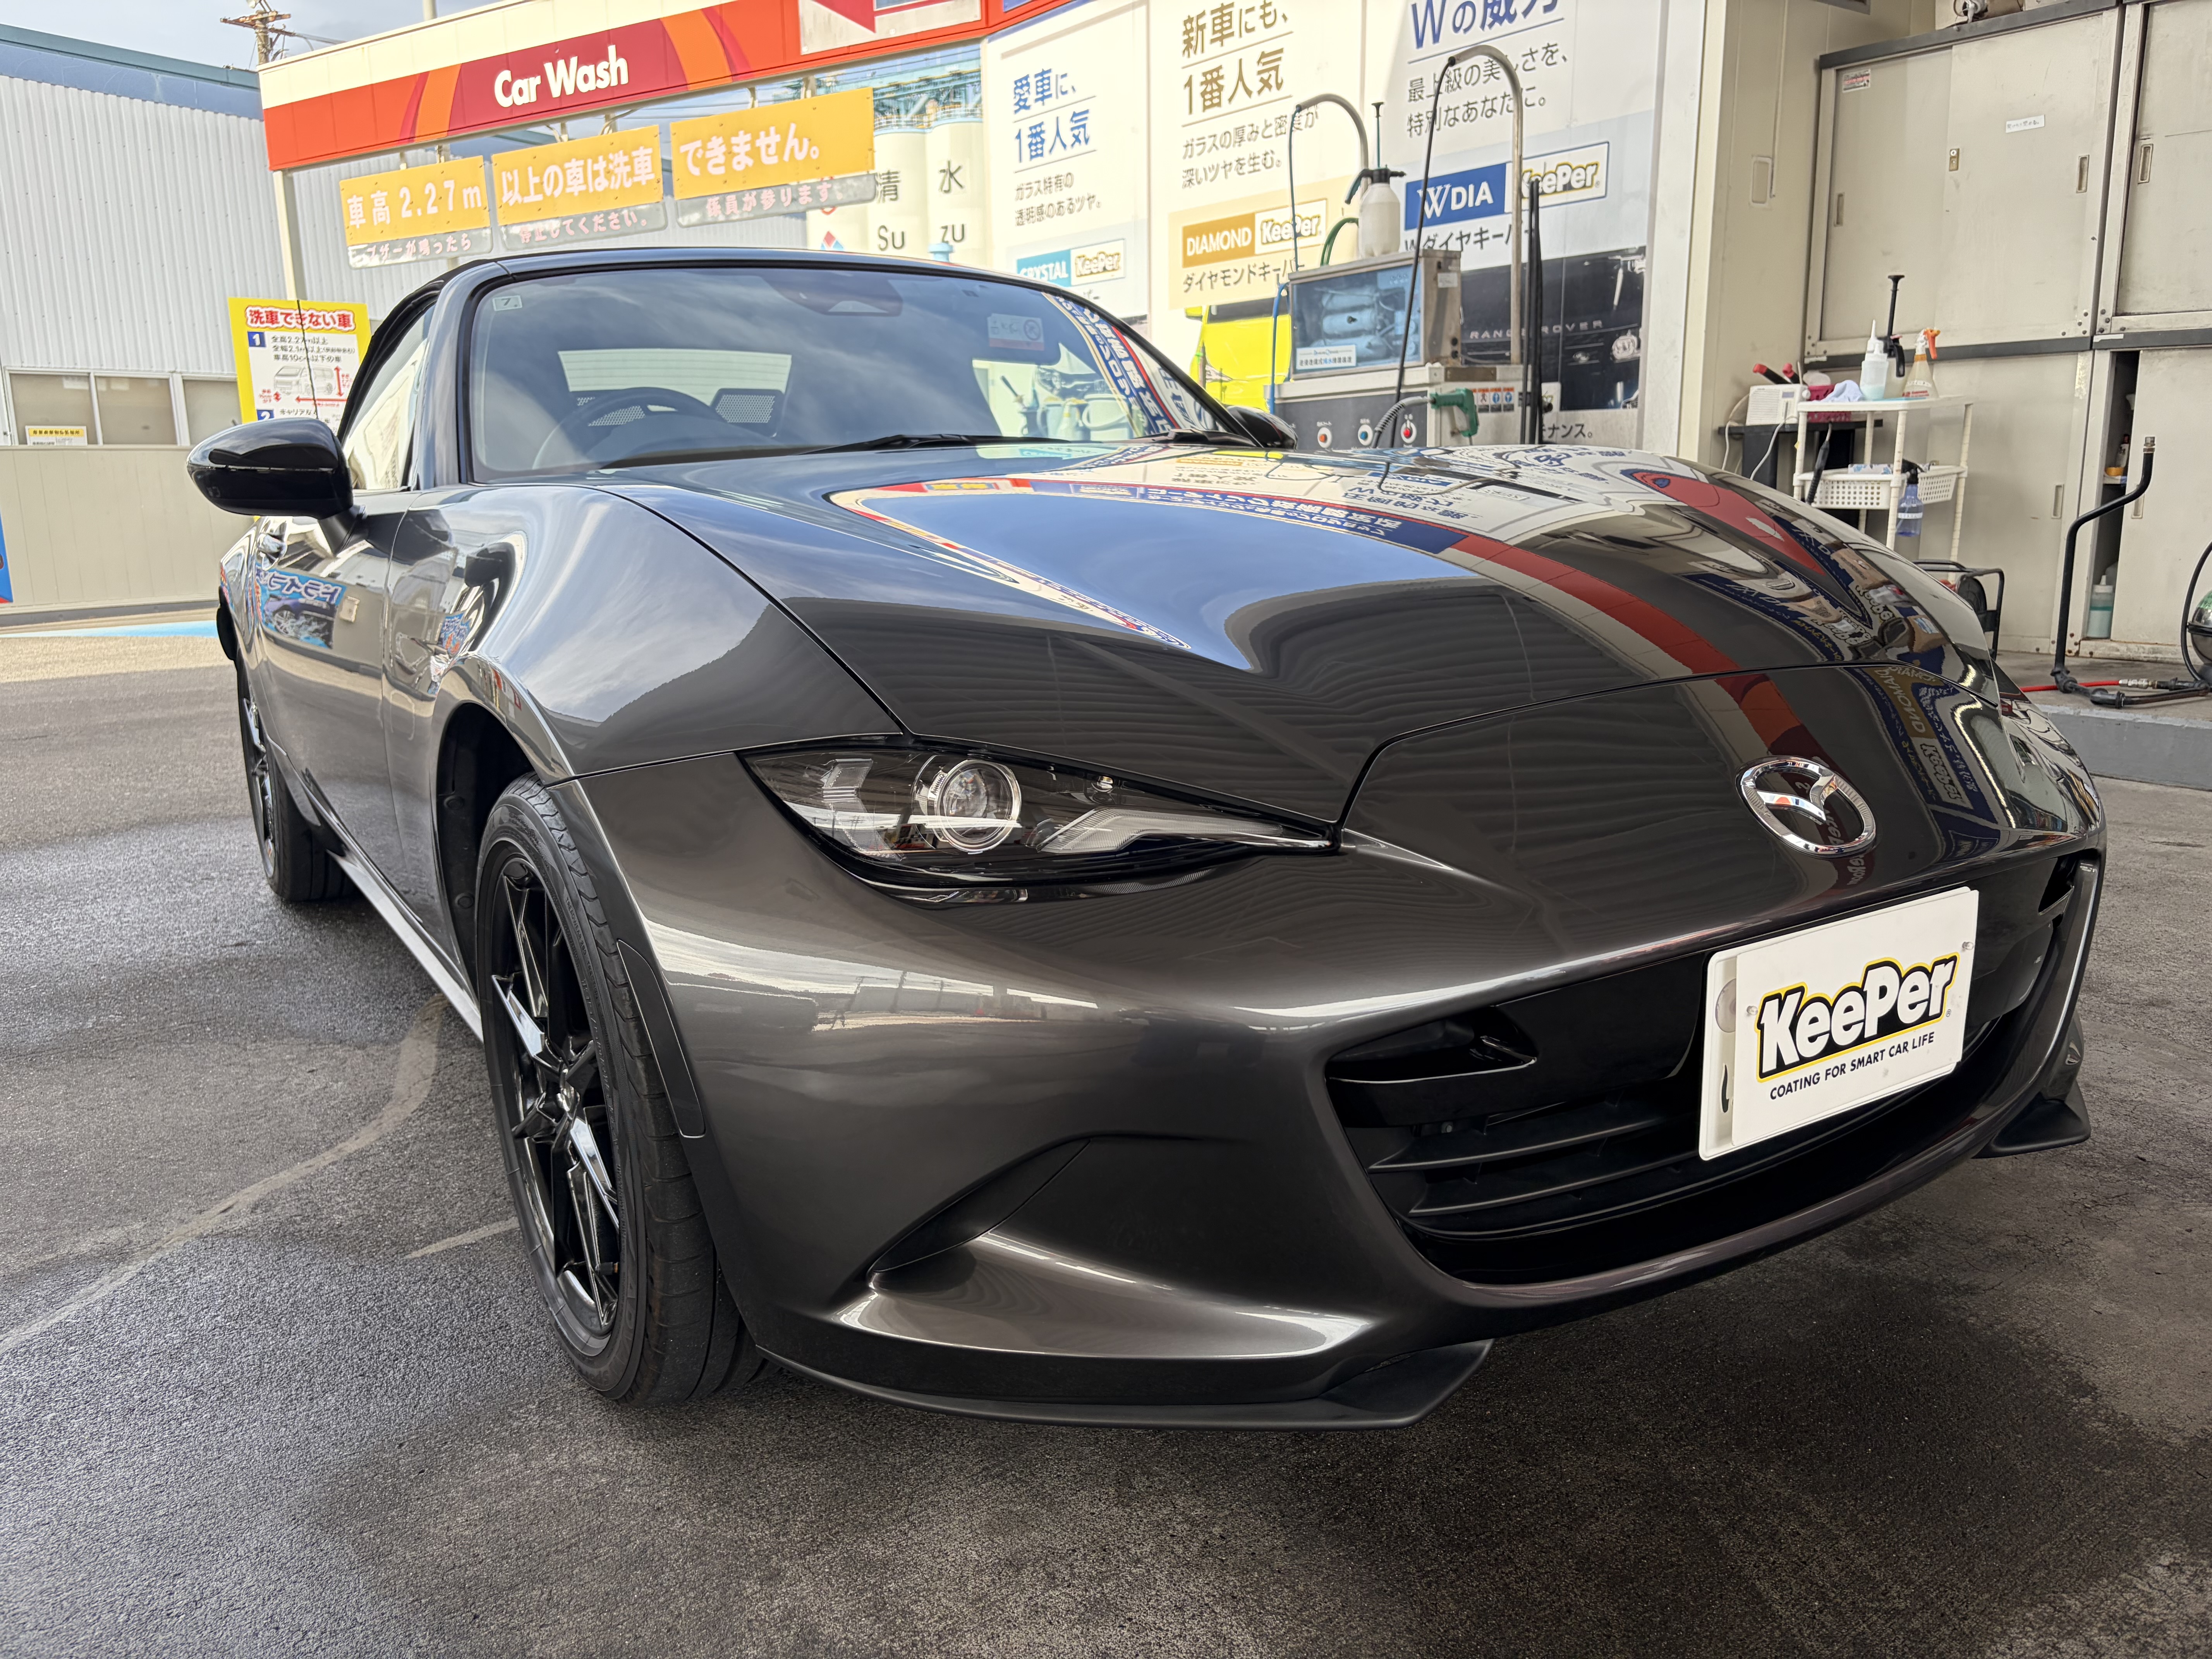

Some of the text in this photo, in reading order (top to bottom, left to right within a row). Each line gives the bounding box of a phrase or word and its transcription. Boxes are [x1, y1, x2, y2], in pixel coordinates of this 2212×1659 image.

[1182, 0, 1288, 58] 新車にも、
[495, 45, 628, 108] Car Wash
[1013, 68, 1077, 115] 愛車に、
[1183, 48, 1285, 115] 1番人気
[1408, 43, 1568, 103] 最上級の美さを、
[680, 122, 820, 177] できません。
[1014, 109, 1091, 163] 1番人気
[501, 146, 655, 206] 以上の車は洗車
[939, 160, 964, 194] 水
[1182, 149, 1282, 189] 深いツヤを生む。
[706, 181, 843, 217] 係員が参ります。
[878, 225, 905, 251] Su
[1187, 227, 1252, 256] DIAMOND
[1075, 251, 1121, 278] KeePer
[249, 309, 352, 328] 洗車できない車
[252, 333, 261, 346] 1
[1756, 953, 1959, 1081] KeePer
[1770, 1031, 1935, 1100] COATING FOR SMART CAR LIFE
